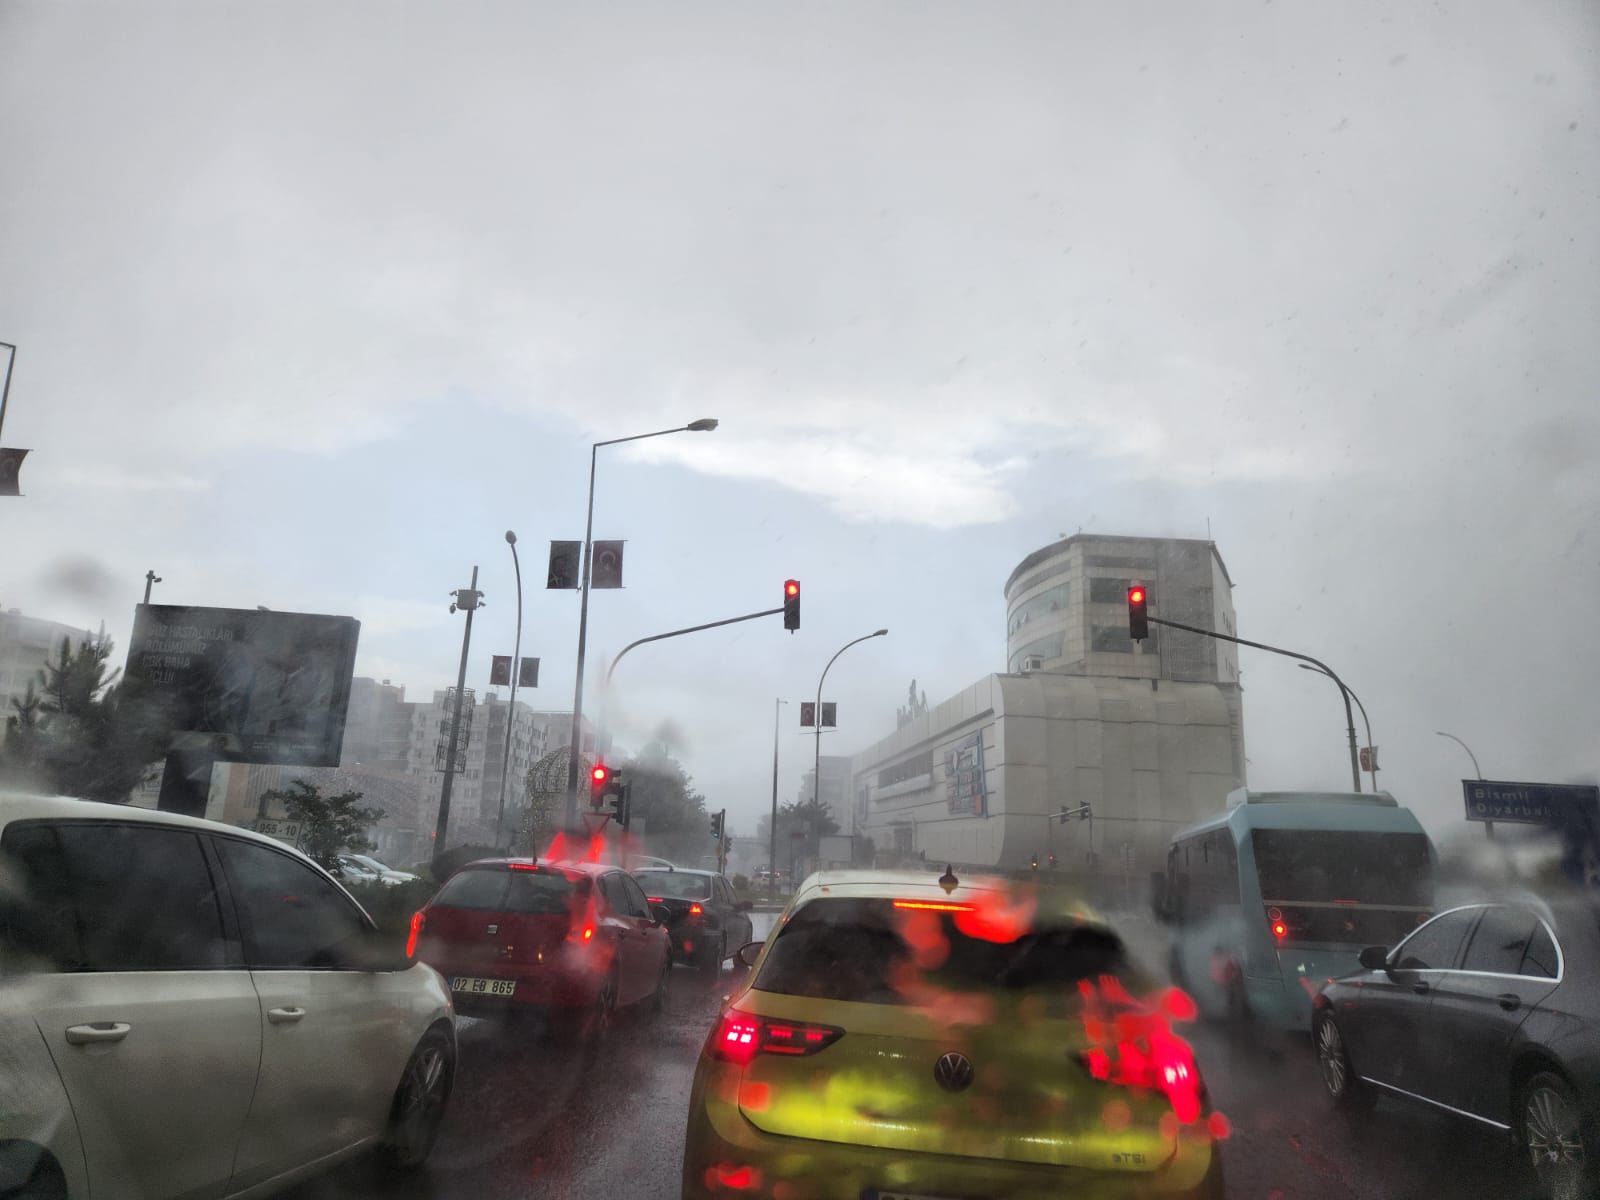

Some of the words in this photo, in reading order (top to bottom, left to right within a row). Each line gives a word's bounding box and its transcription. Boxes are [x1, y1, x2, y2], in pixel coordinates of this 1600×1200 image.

[1475, 787, 1529, 801] Bismil
[454, 978, 468, 991] 02
[492, 981, 513, 994] 865
